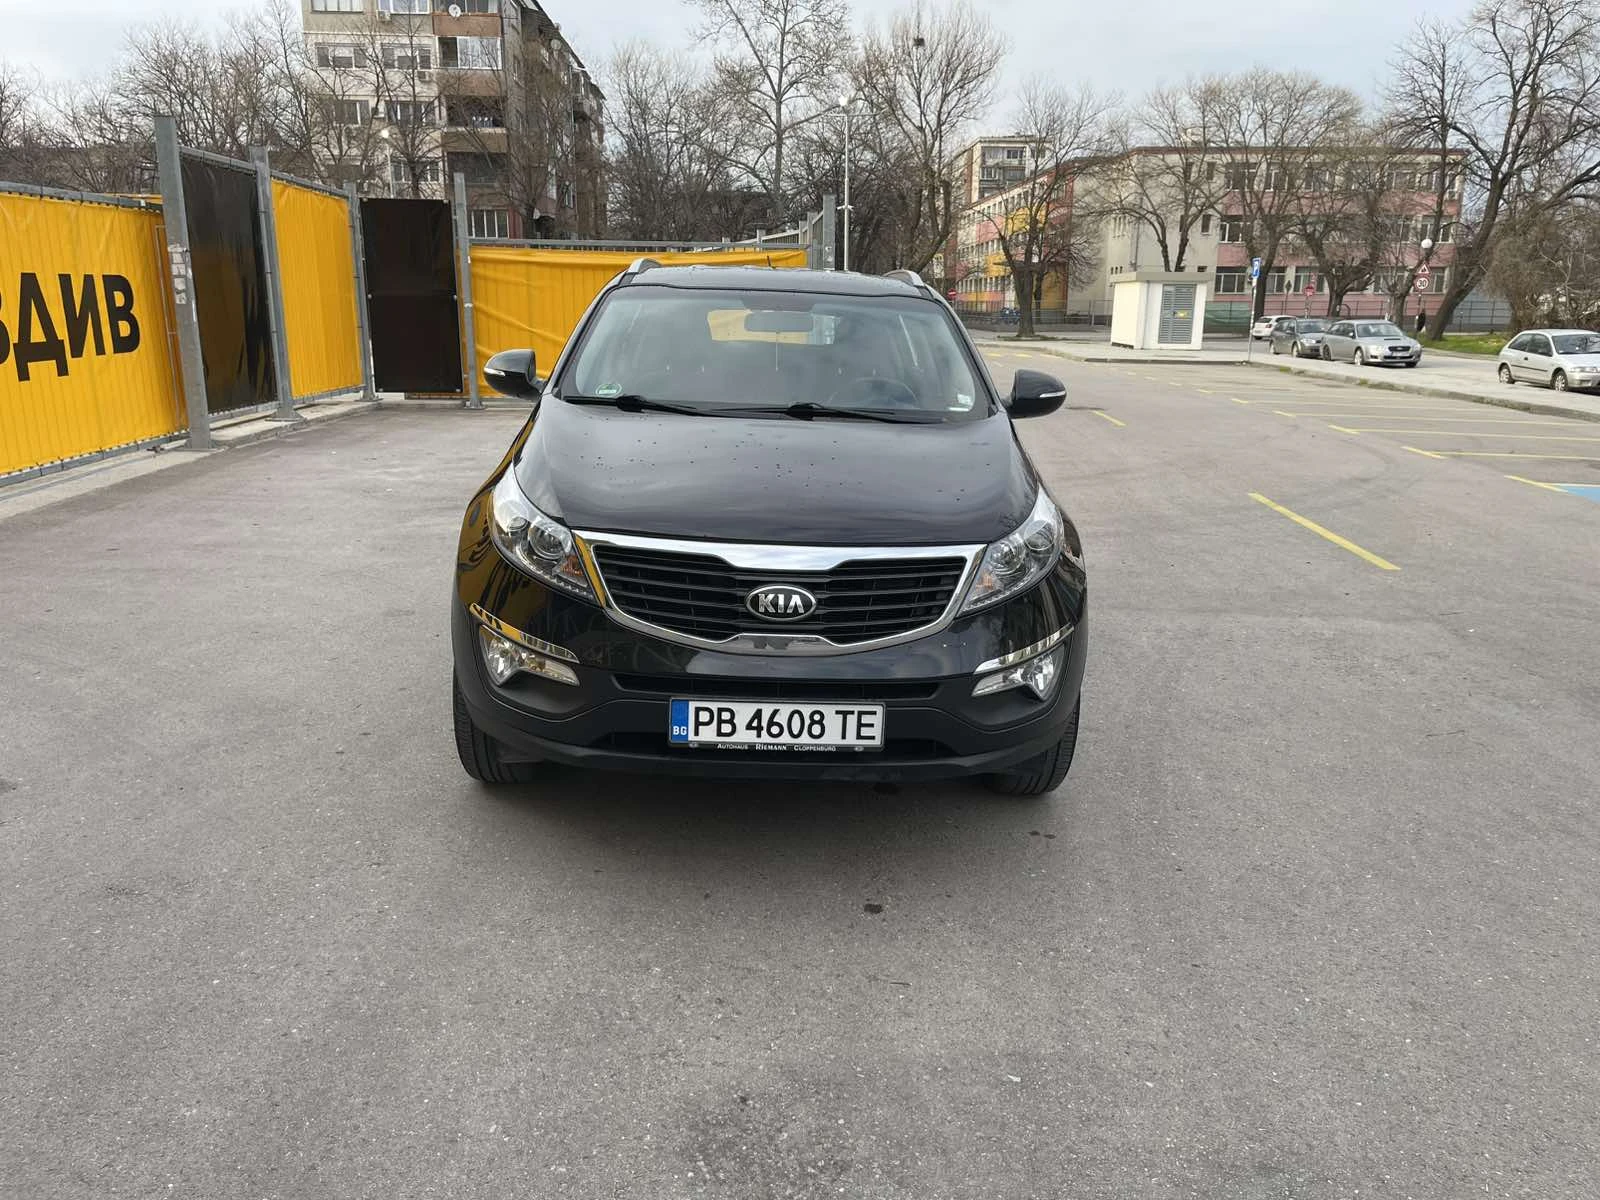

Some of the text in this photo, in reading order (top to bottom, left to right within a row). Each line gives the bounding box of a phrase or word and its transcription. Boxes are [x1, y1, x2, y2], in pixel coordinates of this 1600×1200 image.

[758, 593, 804, 613] KIA
[673, 726, 687, 735] BG
[693, 706, 877, 741] PB 4608 TE
